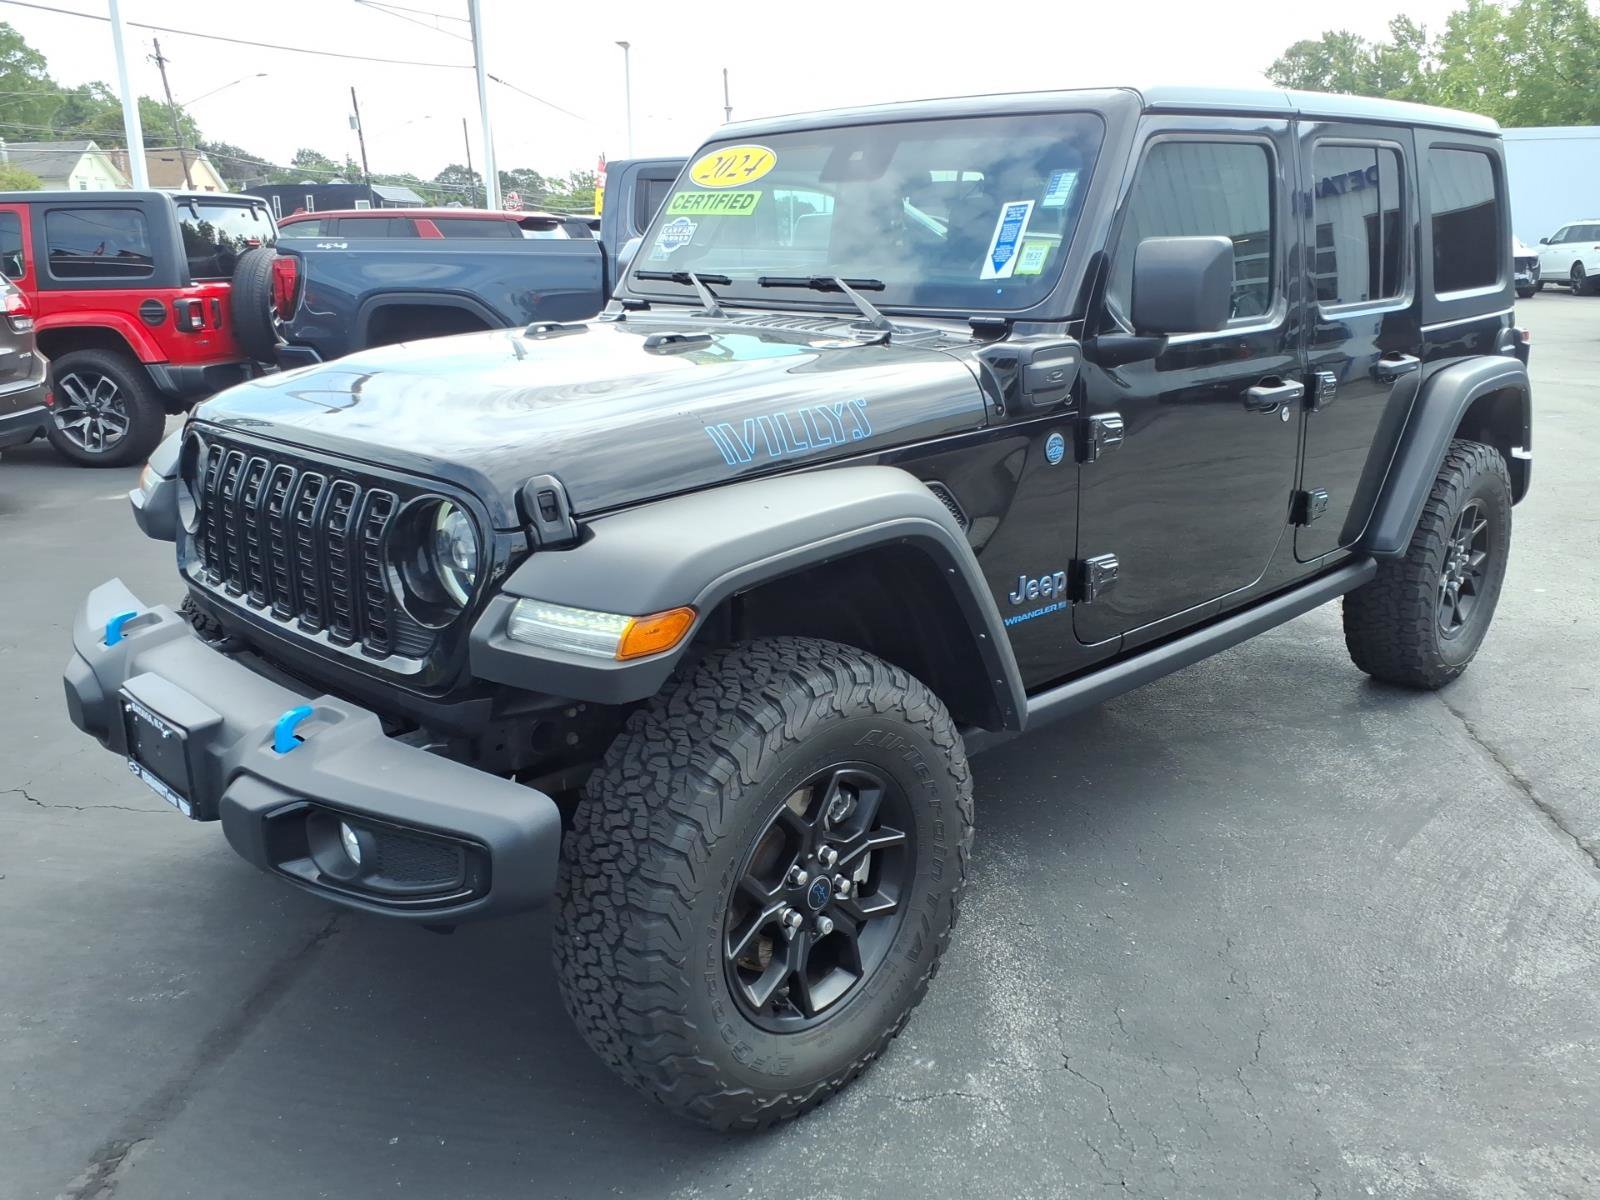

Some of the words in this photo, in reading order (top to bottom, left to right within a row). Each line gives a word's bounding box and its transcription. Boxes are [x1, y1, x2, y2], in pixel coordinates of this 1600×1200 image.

[697, 152, 769, 179] 2024
[671, 193, 755, 210] CERTIFIED
[704, 397, 872, 465] WILLYS
[1009, 571, 1067, 605] Jeep
[1004, 603, 1058, 626] WRANGLER
